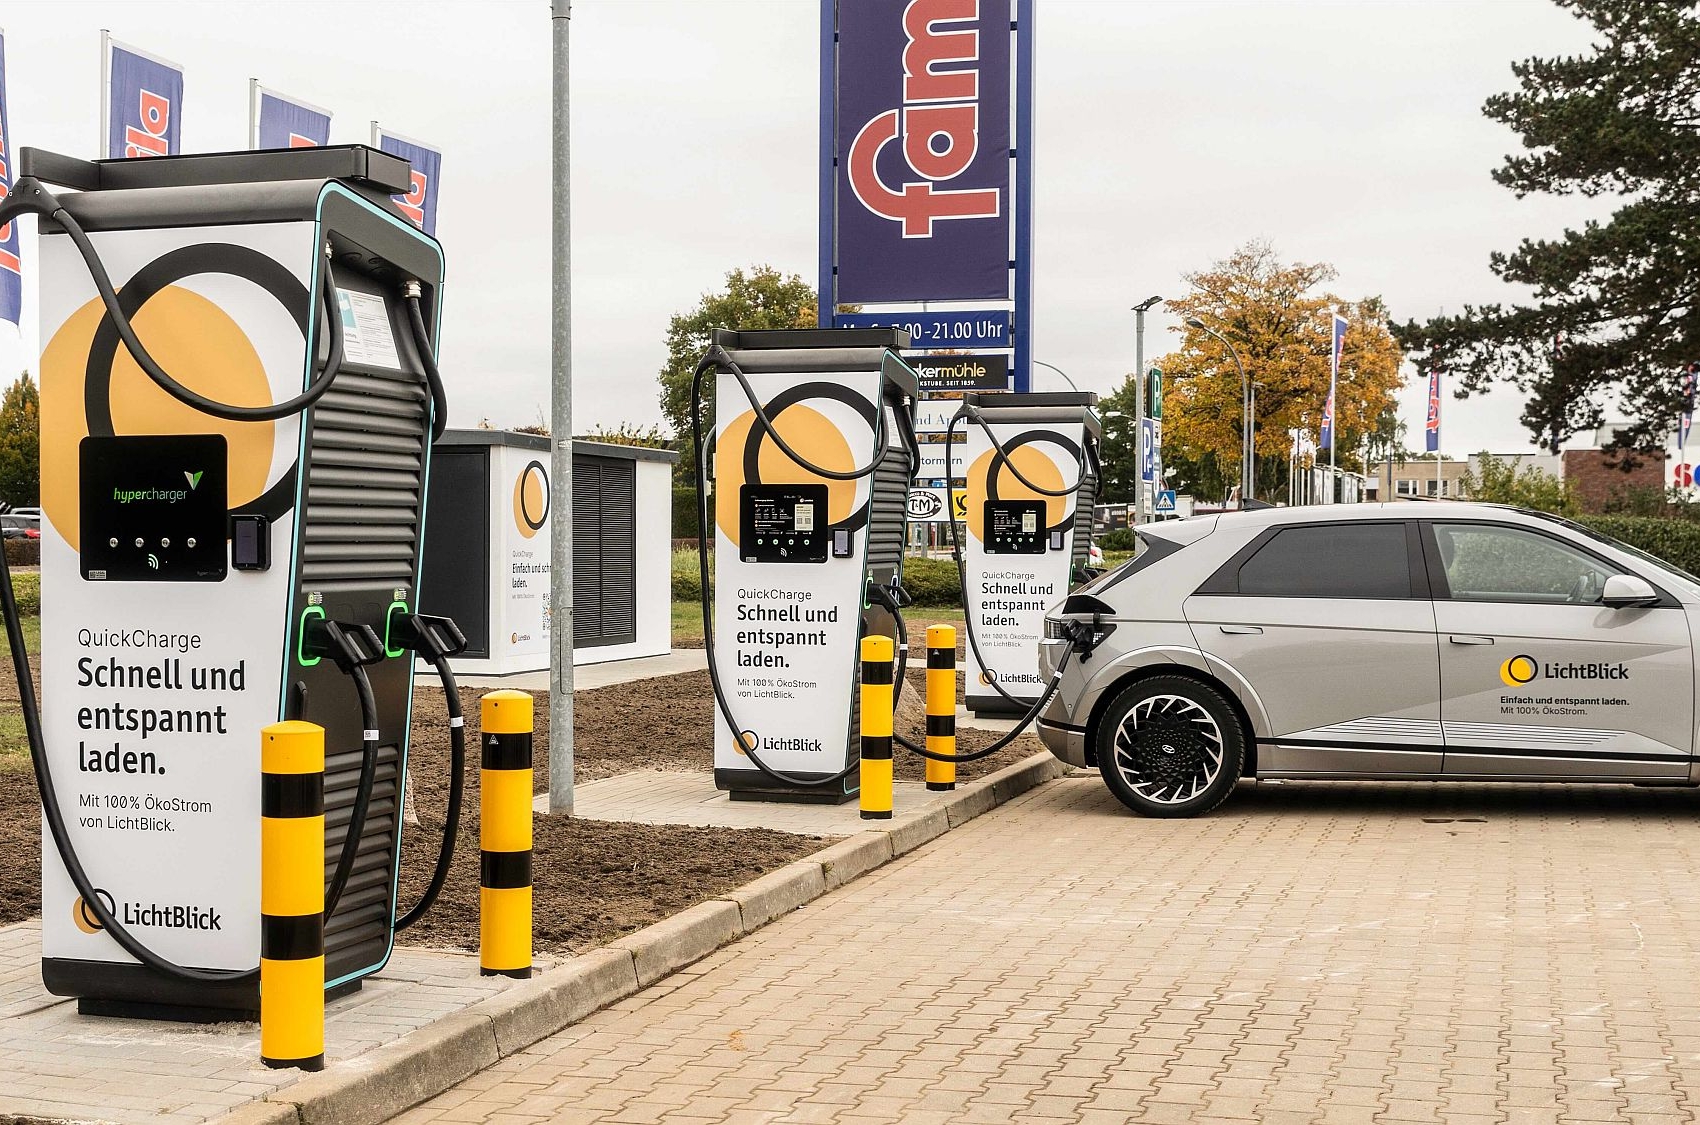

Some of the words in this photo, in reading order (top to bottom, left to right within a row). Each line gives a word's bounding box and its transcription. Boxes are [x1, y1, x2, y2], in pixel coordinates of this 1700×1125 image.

[976, 320, 1003, 338] Uhr
[1154, 374, 1160, 412] P
[1143, 426, 1151, 473] P
[921, 457, 963, 465] tormrn
[113, 487, 188, 504] hypercharger
[512, 563, 531, 574] Einfach
[531, 563, 541, 574] und
[981, 571, 1035, 581] QuickCharge
[512, 577, 528, 588] laden.
[981, 582, 1027, 595] Schnell
[1030, 583, 1053, 595] und
[737, 588, 812, 602] QuickCharge
[737, 604, 801, 622] Schnell
[805, 606, 838, 623] und
[981, 599, 1046, 612] entspannt
[982, 614, 1019, 626] laden.
[78, 628, 202, 653] QuickCharge
[736, 629, 827, 648] entspannt
[737, 650, 790, 668] laden.
[77, 656, 183, 690] Schnell
[191, 659, 246, 692] und
[1000, 673, 1041, 684] LichtBlick
[1545, 663, 1629, 680] LichtBlick
[737, 678, 750, 687] Mit
[776, 678, 817, 689] ÖkoStrom
[737, 690, 752, 698] von
[754, 689, 795, 699] LichtBlick.
[1500, 696, 1533, 704] Einfach
[1535, 697, 1552, 705] und
[1554, 697, 1600, 706] entspannt
[1601, 697, 1630, 706] laden.
[1500, 706, 1514, 715] Mit
[1516, 707, 1539, 715] 100%
[1542, 705, 1588, 716] ÖkoStrom.
[77, 702, 227, 740] entspannt
[763, 737, 822, 752] LichtBlick
[79, 741, 166, 775] laden.
[79, 794, 100, 808] Mit
[144, 794, 212, 813] ÖkoStrom
[79, 816, 103, 829] von
[107, 815, 175, 832] LichtBlick.
[124, 902, 222, 931] LichtBlick
